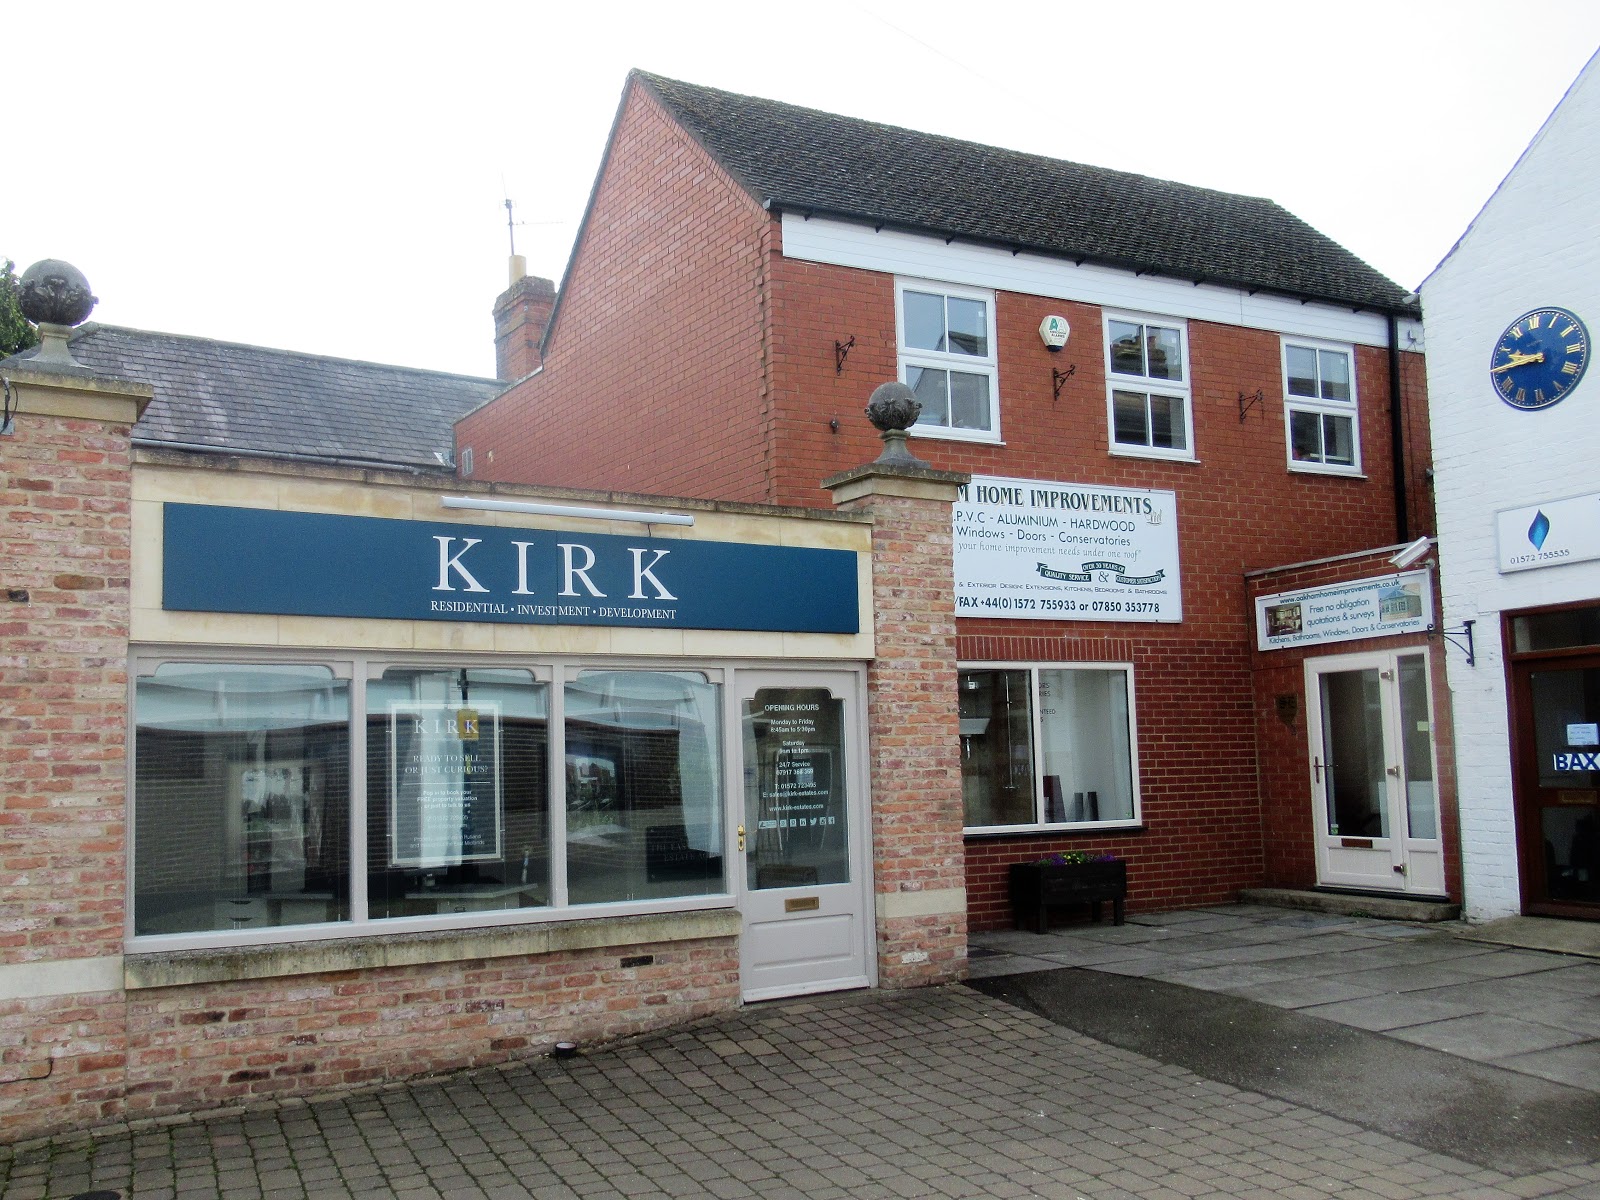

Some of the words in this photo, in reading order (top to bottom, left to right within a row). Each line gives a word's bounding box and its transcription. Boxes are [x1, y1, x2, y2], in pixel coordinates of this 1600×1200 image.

[976, 485, 1024, 507] HOME
[1030, 489, 1153, 515] IMPROVEMENTS
[997, 513, 1059, 528] ALUMINIUM
[1070, 518, 1136, 532] HARDWOOD
[956, 525, 1005, 539] Windows
[1017, 529, 1047, 541] Doors
[1058, 531, 1131, 546] Conservatories
[957, 542, 977, 554] your
[979, 540, 1002, 552] home
[1005, 543, 1055, 556] improvement
[1058, 545, 1081, 556] needs
[1082, 547, 1105, 557] under
[431, 535, 678, 600] KIRK
[1510, 554, 1536, 565] 01572
[1044, 569, 1067, 580] QUALITY
[1068, 573, 1089, 581] SERVICE
[1098, 571, 1109, 583] &
[1280, 579, 1400, 604] www.oakhamhomeimprovements.co.uk
[431, 600, 509, 614] RESIDENTIAL
[517, 604, 591, 616] INVESTMENT
[599, 606, 677, 620] DEVELOPMENT
[1040, 599, 1076, 611] 755933
[1079, 603, 1089, 611] or
[1092, 601, 1122, 612] 07850
[1125, 602, 1160, 613] 353778
[1309, 603, 1324, 613] Free
[1336, 598, 1370, 610] obligation
[1307, 614, 1341, 628] quotations
[1342, 612, 1348, 621] &
[1350, 610, 1375, 620] surveys
[1322, 627, 1351, 637] Windows,
[1352, 625, 1369, 634] Doors
[1370, 623, 1375, 631] &
[1376, 618, 1420, 631] Conservatories
[413, 719, 479, 734] KIRK
[413, 754, 442, 762] READY
[445, 754, 458, 762] TO
[460, 754, 481, 762] SELL
[404, 766, 419, 774] OR
[420, 766, 442, 775] JUST
[444, 765, 489, 774] CURIOUS?
